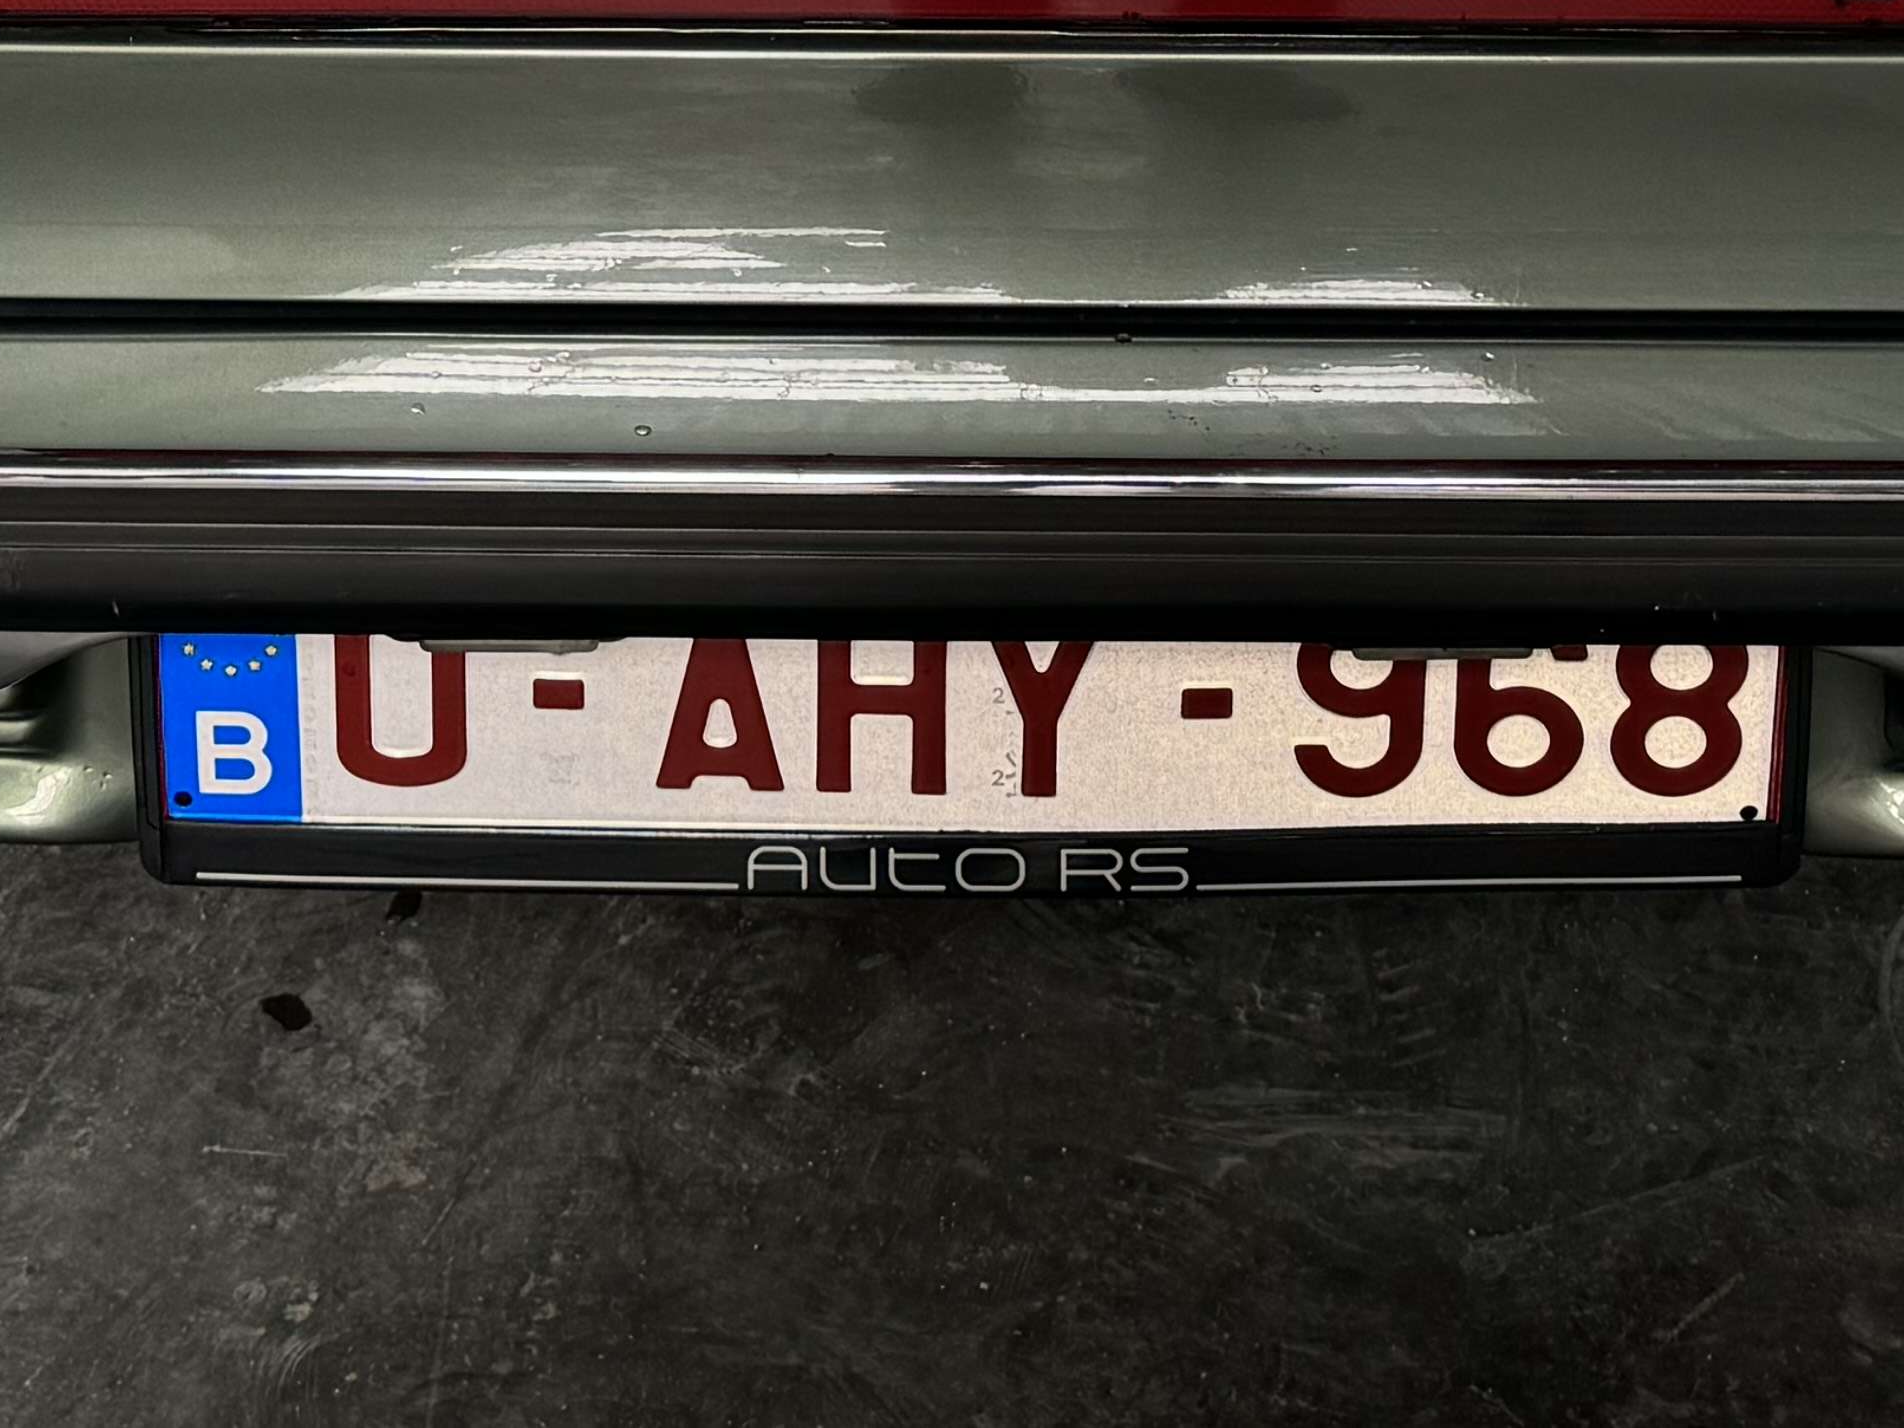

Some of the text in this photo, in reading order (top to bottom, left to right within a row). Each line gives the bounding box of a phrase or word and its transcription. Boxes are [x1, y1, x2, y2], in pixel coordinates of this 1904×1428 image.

[195, 710, 273, 795] B
[747, 845, 1190, 892] AUTO RS
